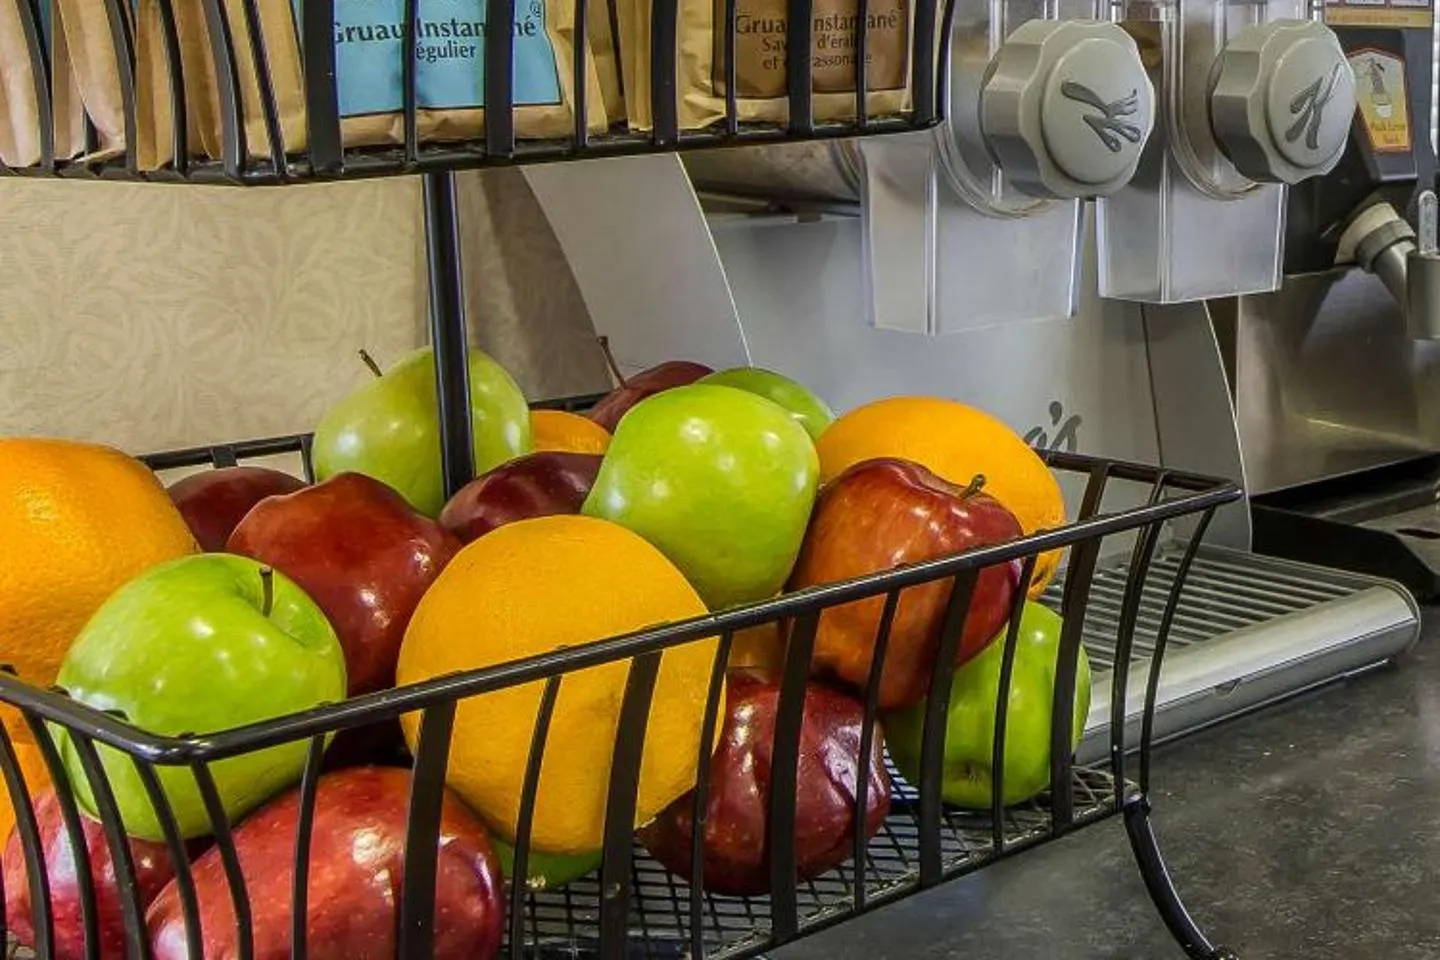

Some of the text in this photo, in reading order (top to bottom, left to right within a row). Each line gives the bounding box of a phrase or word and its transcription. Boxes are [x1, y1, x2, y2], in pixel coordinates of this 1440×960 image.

[416, 14, 537, 40] Instanné
[736, 14, 787, 36] Grua
[416, 40, 477, 64] égulier
